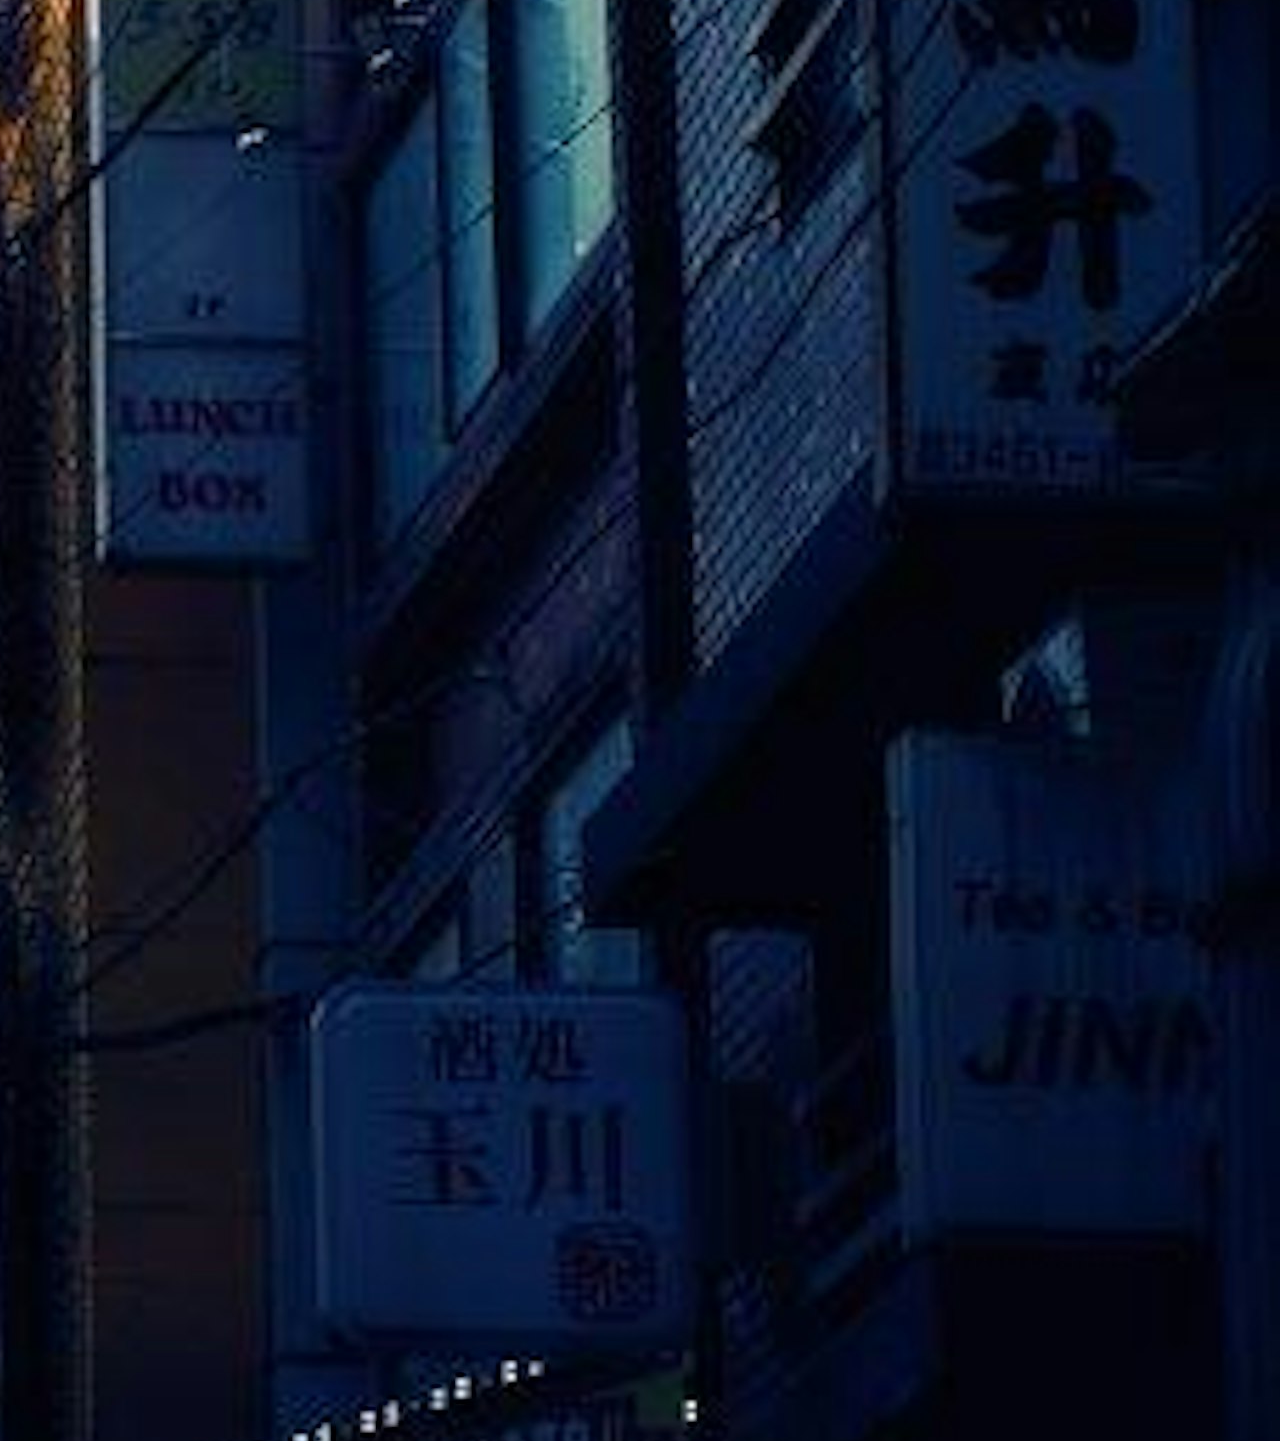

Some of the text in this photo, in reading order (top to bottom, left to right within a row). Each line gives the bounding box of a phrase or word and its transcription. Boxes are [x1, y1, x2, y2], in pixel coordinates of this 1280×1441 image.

[118, 395, 302, 437] LUNCH
[159, 469, 267, 513] BOX
[374, 1102, 624, 1213] 玉川
